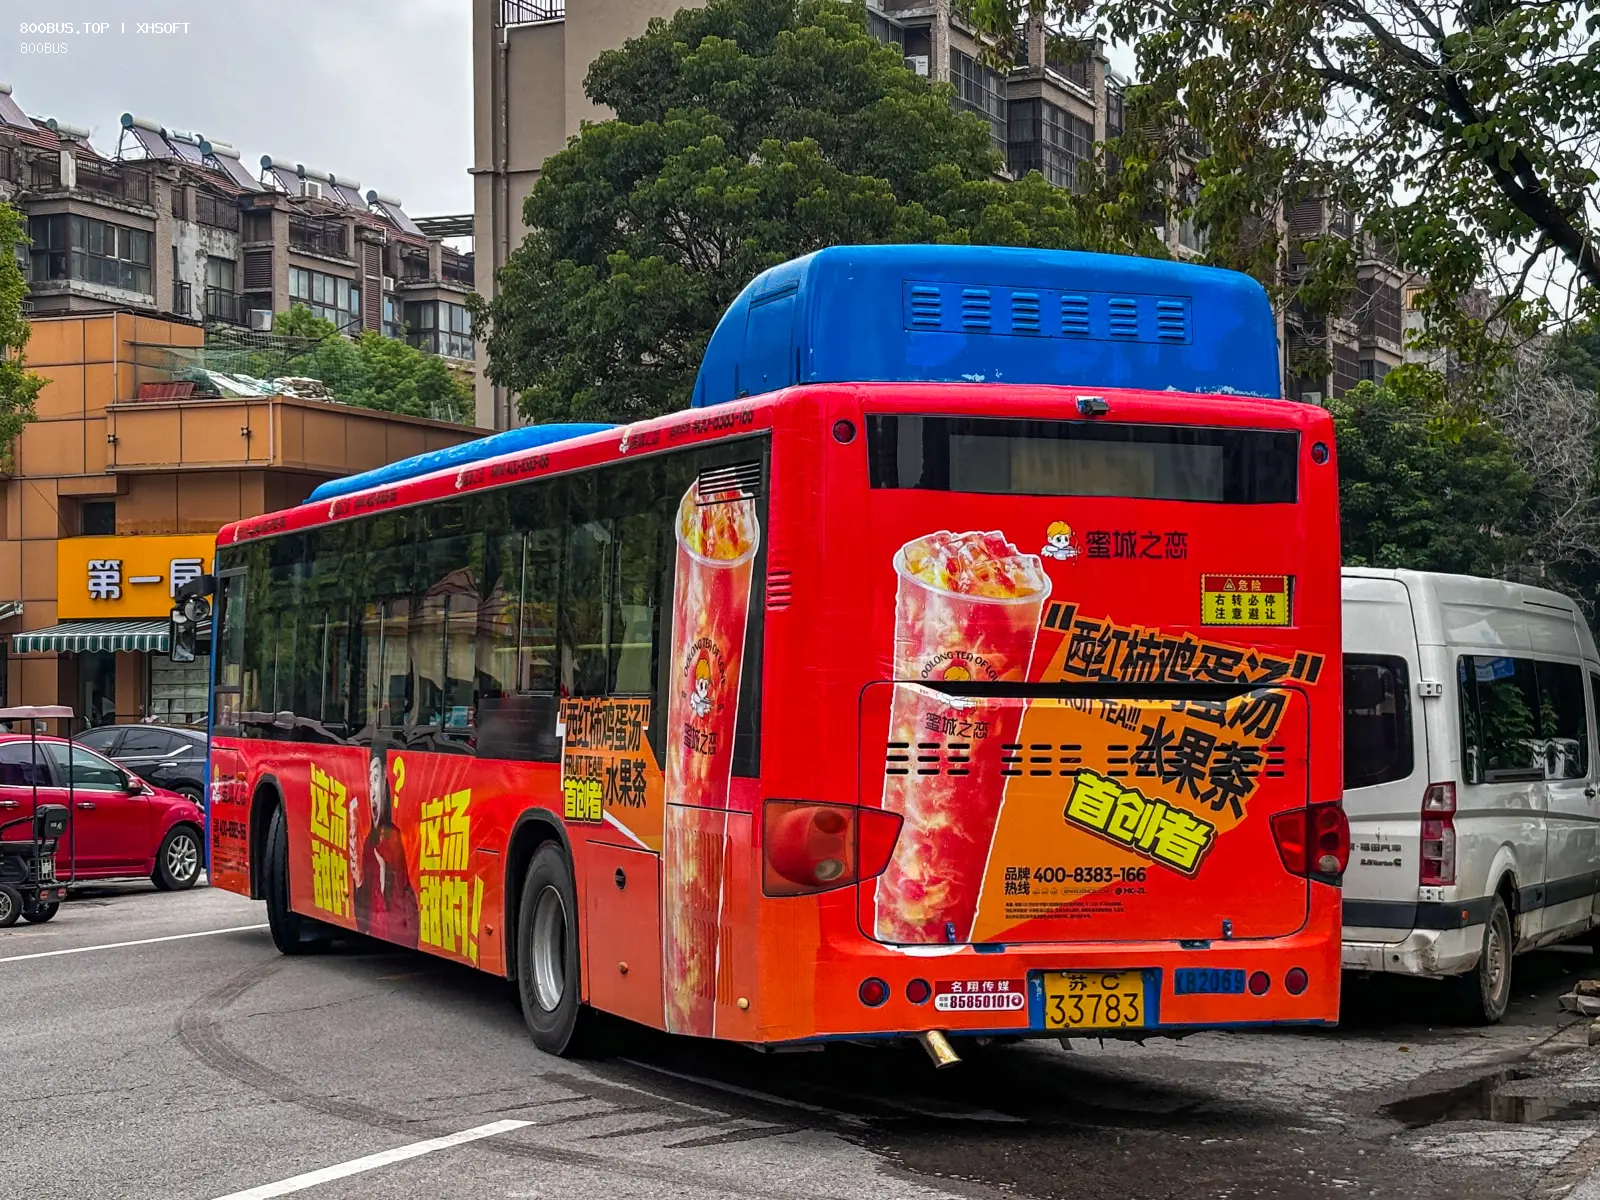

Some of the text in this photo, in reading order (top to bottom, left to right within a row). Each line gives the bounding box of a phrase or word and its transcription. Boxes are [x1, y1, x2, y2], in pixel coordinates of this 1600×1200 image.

[1086, 530, 1189, 559] 蜜城之恋
[1238, 579, 1262, 591] 危险
[1215, 594, 1276, 607] 右转必停
[1215, 607, 1276, 620] 注意避让
[921, 651, 954, 679] OOLONG
[955, 650, 974, 663] TEA
[974, 656, 987, 669] OF
[925, 712, 990, 739] 蜜城之恋
[605, 757, 647, 808] 水果茶
[1130, 716, 1264, 820] 水果茶
[310, 762, 347, 851] 这汤
[564, 778, 603, 819] 首创者
[419, 788, 472, 871] 这汤
[1066, 771, 1212, 870] 首创者
[1005, 866, 1147, 883] 品牌 400-8383-166
[1005, 881, 1031, 896] 热线
[949, 994, 1011, 1009] 85850101
[1049, 993, 1139, 1024] 33783
